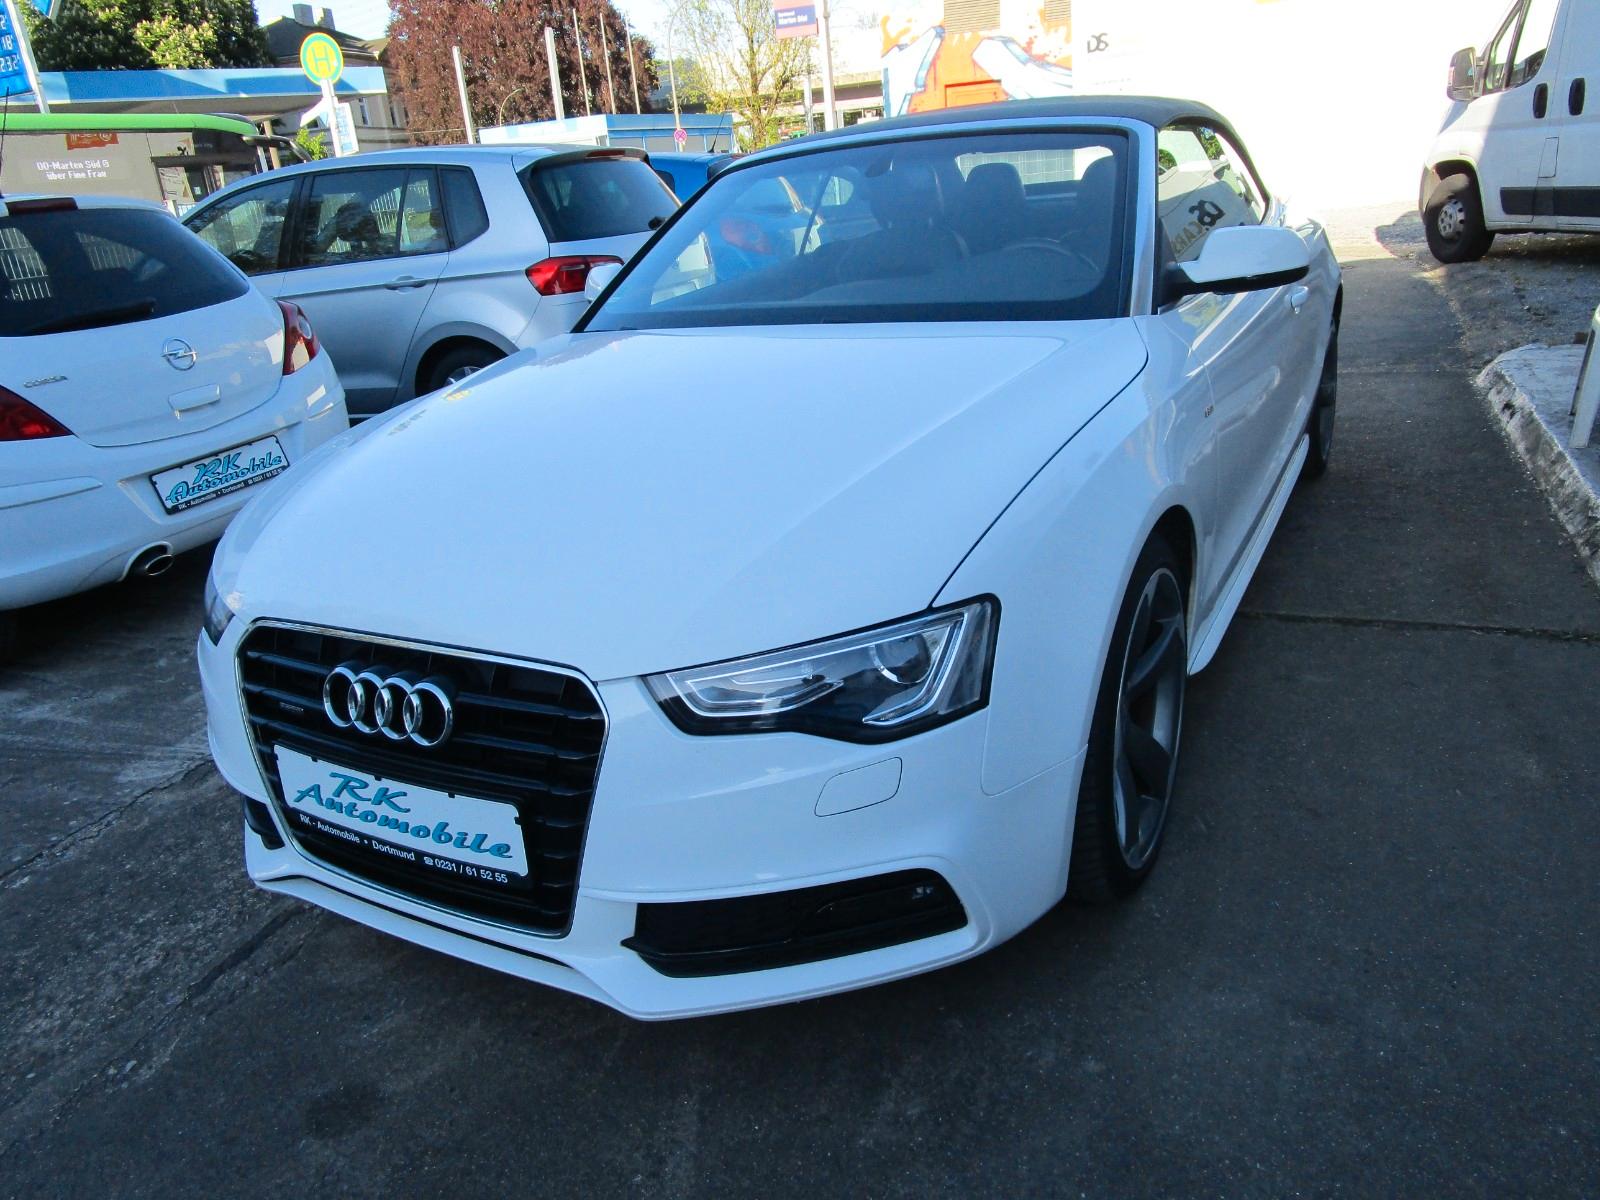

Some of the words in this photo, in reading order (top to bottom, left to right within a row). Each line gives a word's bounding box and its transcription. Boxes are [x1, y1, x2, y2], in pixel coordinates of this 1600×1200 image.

[310, 46, 332, 74] H
[165, 451, 283, 504] Automobile
[193, 451, 242, 485] RK
[328, 772, 411, 813] RK
[293, 783, 513, 859] Automobile
[300, 813, 313, 826] RK
[317, 820, 361, 843] Automobile
[372, 839, 416, 861] Dortmund
[434, 859, 457, 873] 0231
[465, 866, 478, 877] 61
[480, 869, 494, 881] 52
[494, 872, 509, 884] 55
